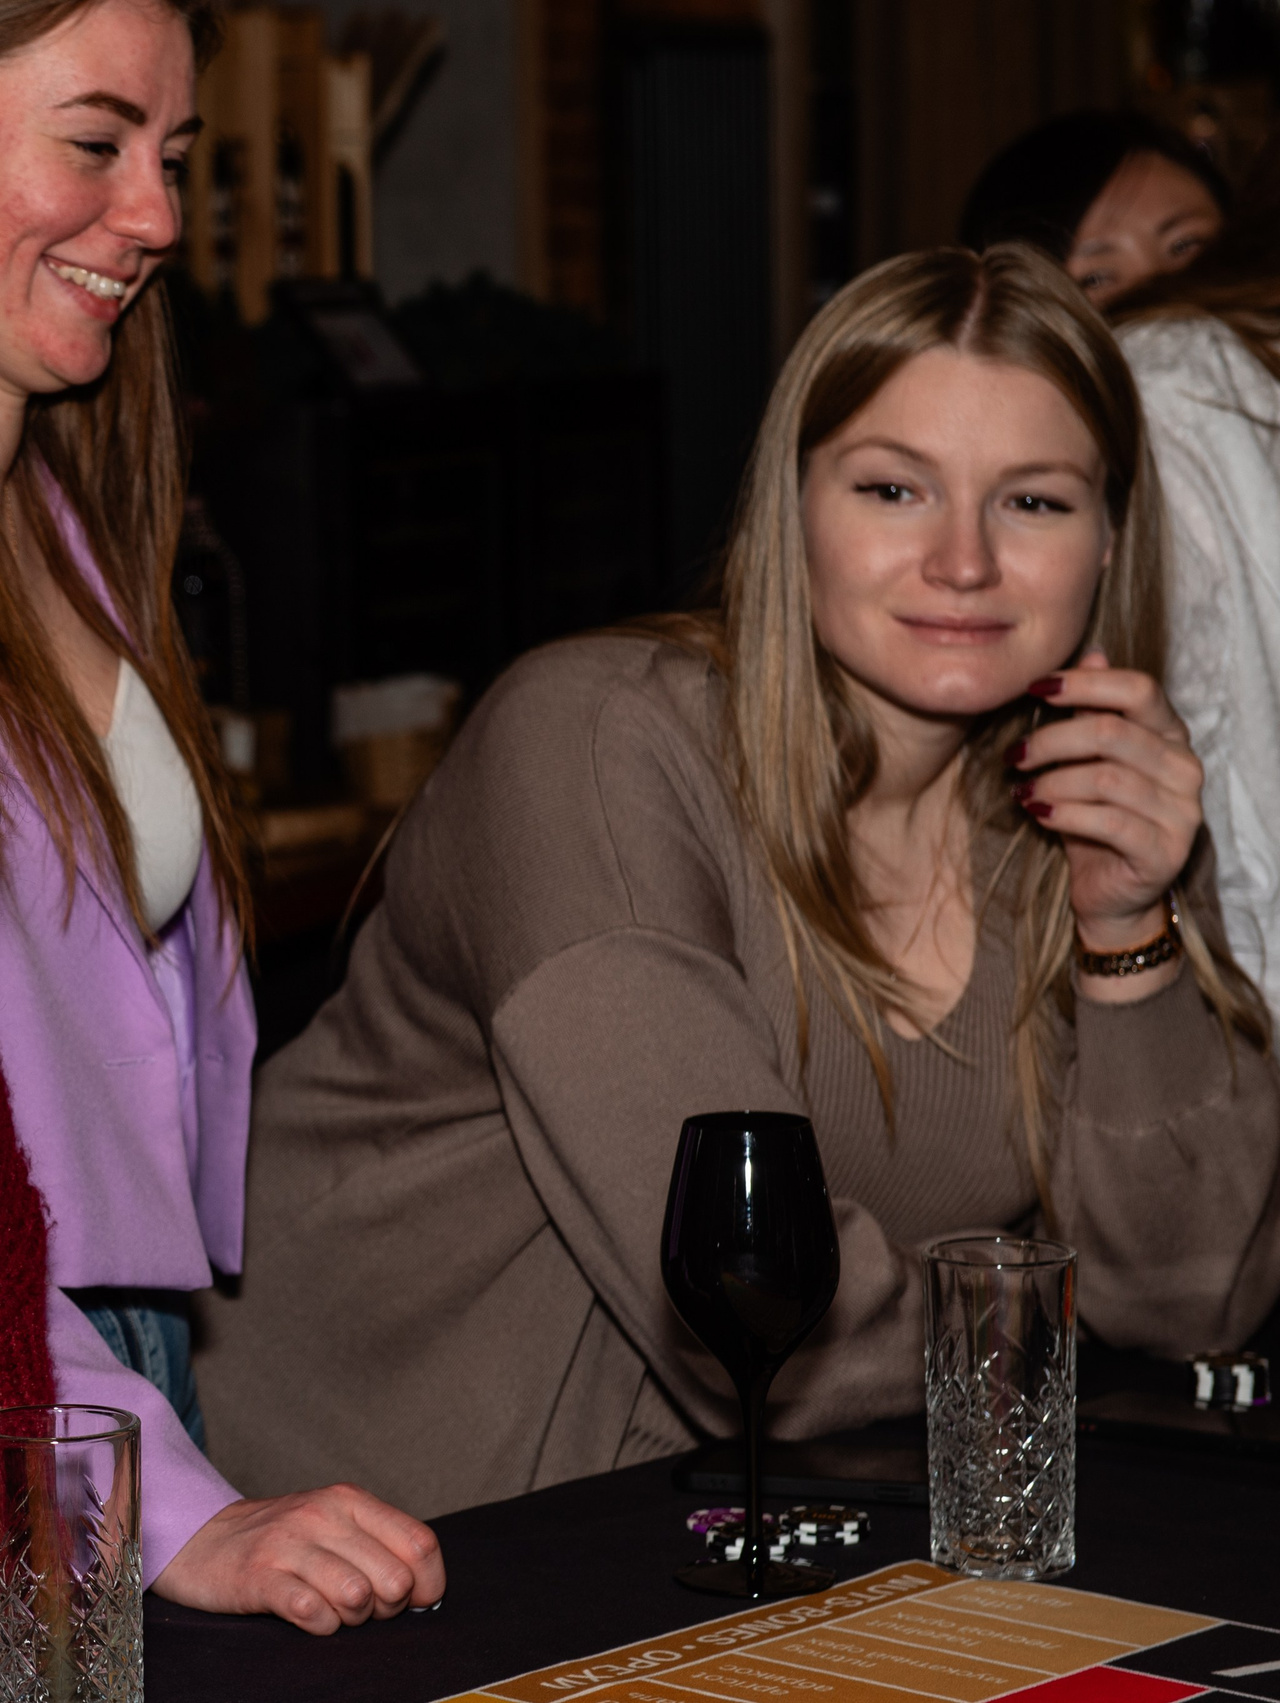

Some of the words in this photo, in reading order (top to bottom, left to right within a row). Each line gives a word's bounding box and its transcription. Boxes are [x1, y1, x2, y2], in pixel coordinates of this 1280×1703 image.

[696, 1574, 933, 1646] NUTS-BONES
[956, 1593, 1024, 1612] other
[974, 1585, 1073, 1609] другое
[892, 1610, 955, 1630] орех
[807, 1636, 865, 1654] орех
[866, 1619, 982, 1648] hazelnut
[958, 1625, 1062, 1650] лесной
[783, 1643, 877, 1669] nutmeg
[540, 1649, 683, 1690] ОРЕХИ
[719, 1663, 835, 1692] абрикос
[690, 1670, 790, 1696] apricot
